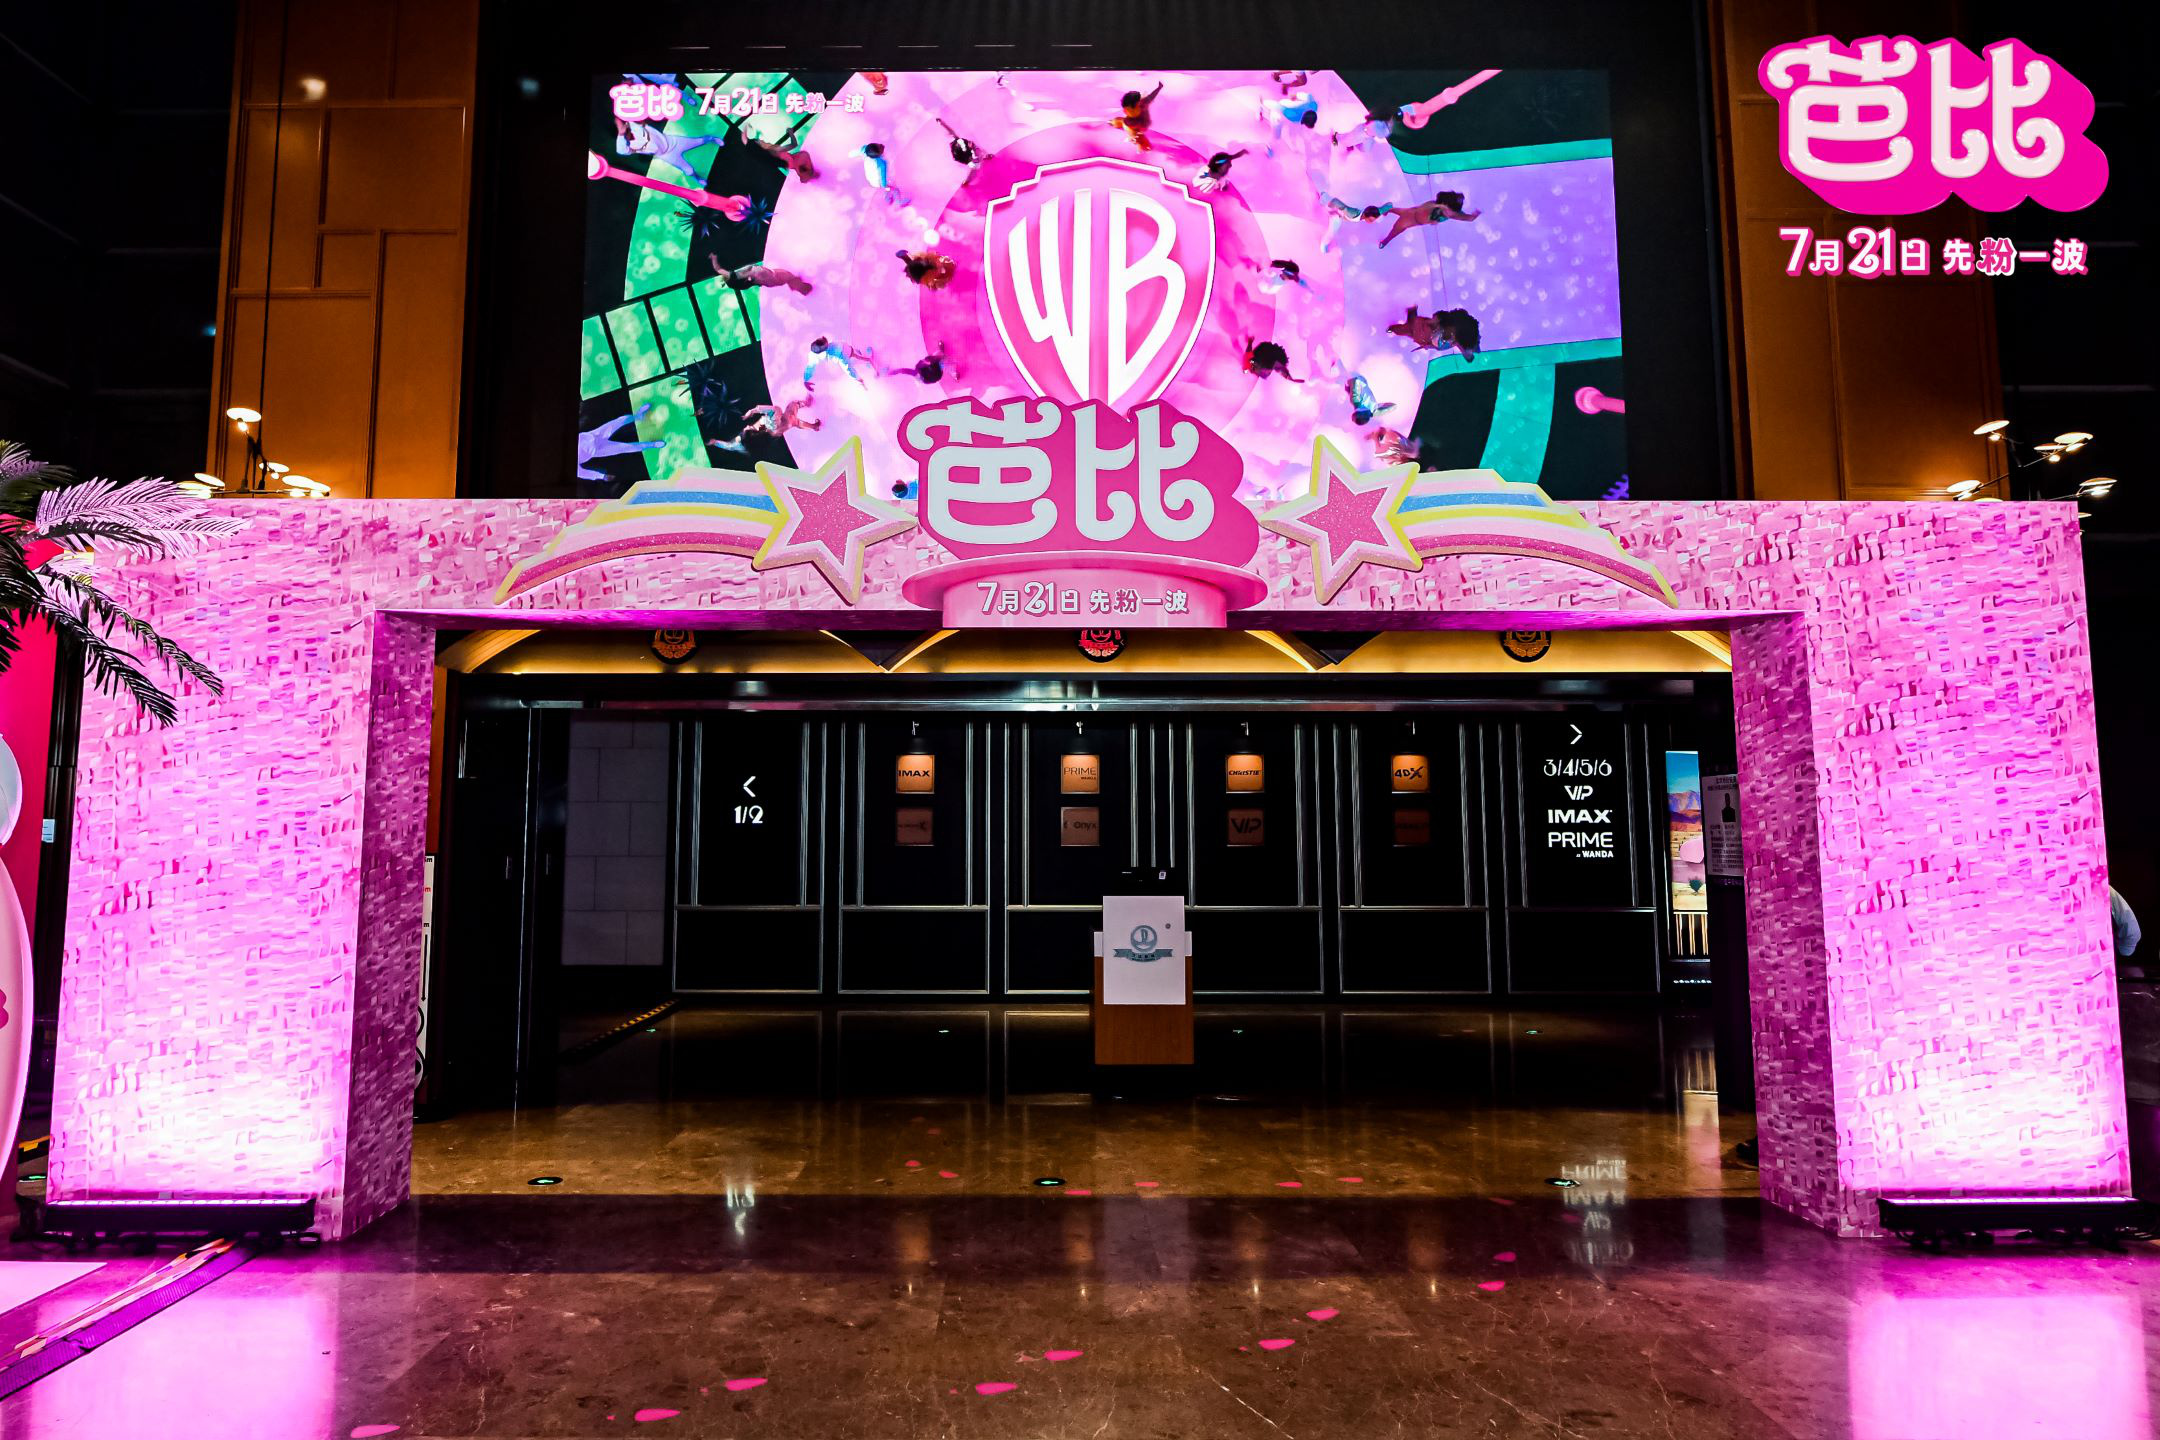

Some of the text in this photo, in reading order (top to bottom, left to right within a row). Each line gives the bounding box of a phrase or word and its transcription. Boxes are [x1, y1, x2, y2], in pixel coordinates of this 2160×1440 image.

[609, 84, 865, 120] 芭比 7月21日 先粉一波
[1008, 187, 1187, 407] WB
[905, 400, 1215, 545] 芭比
[977, 581, 1190, 616] 7月21日 先粉一波
[1063, 767, 1097, 776] PRIME
[1543, 758, 1613, 777] 3/4/5/6
[1563, 785, 1594, 801] VIP
[734, 804, 764, 824] 1/2
[1547, 809, 1613, 824] IMAX
[1230, 817, 1263, 834] VIP
[1547, 831, 1614, 848] PRIME
[1581, 850, 1614, 858] WANDA
